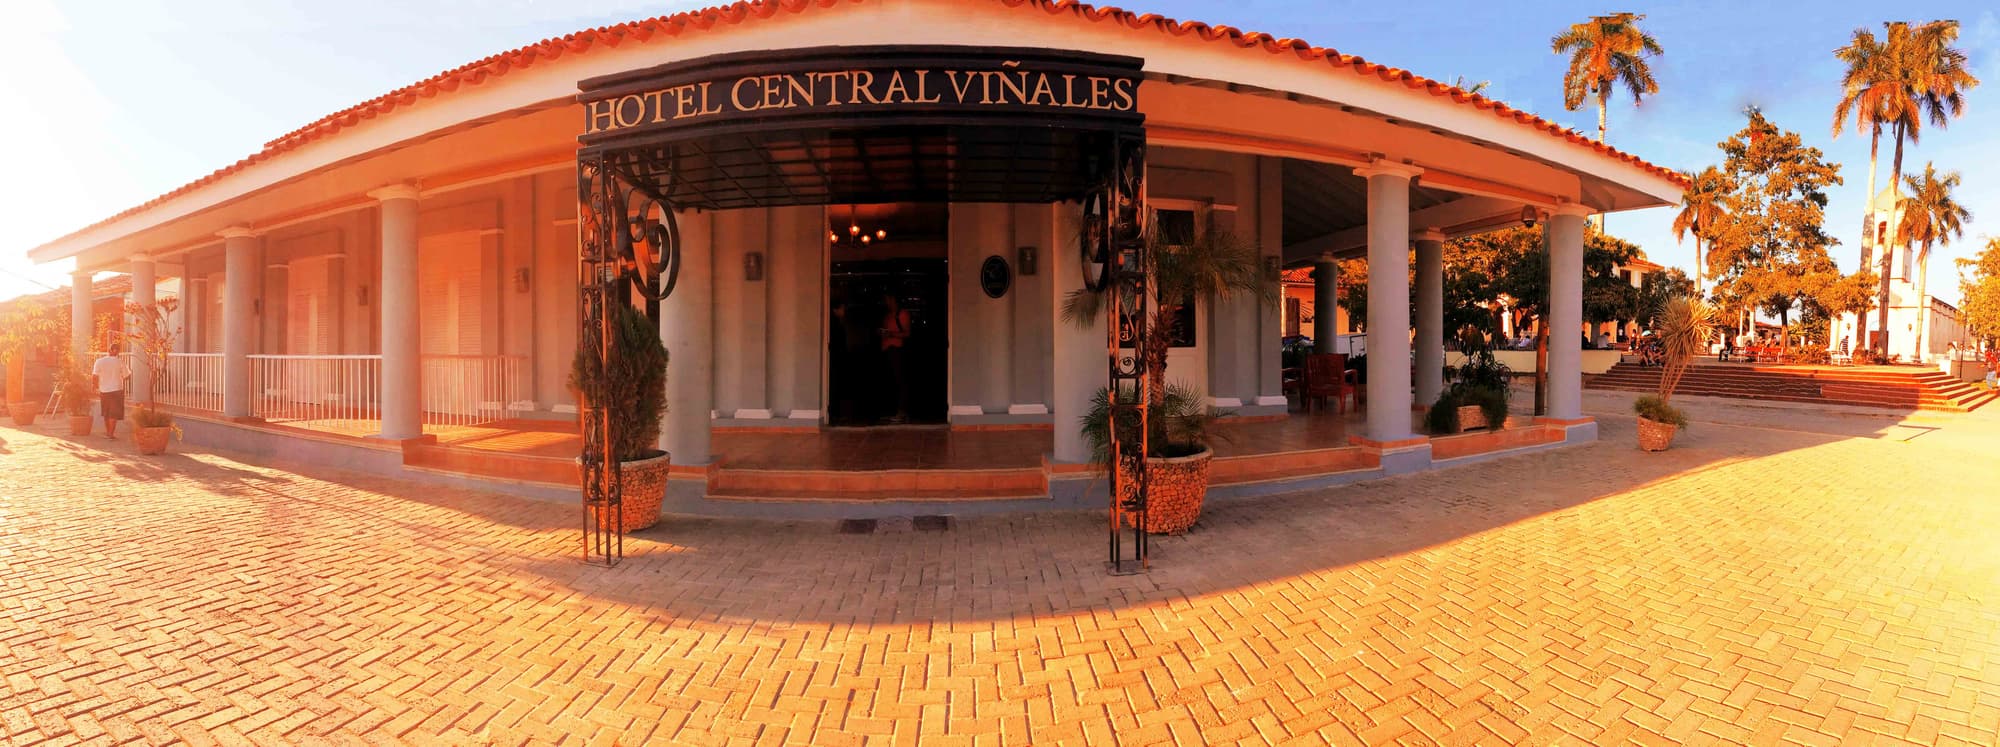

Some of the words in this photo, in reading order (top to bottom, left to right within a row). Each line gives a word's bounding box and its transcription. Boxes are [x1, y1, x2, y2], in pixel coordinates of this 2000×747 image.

[588, 81, 722, 134] HOTEL
[731, 69, 941, 112] CENTRAL
[945, 60, 1134, 111] VIÑALES
